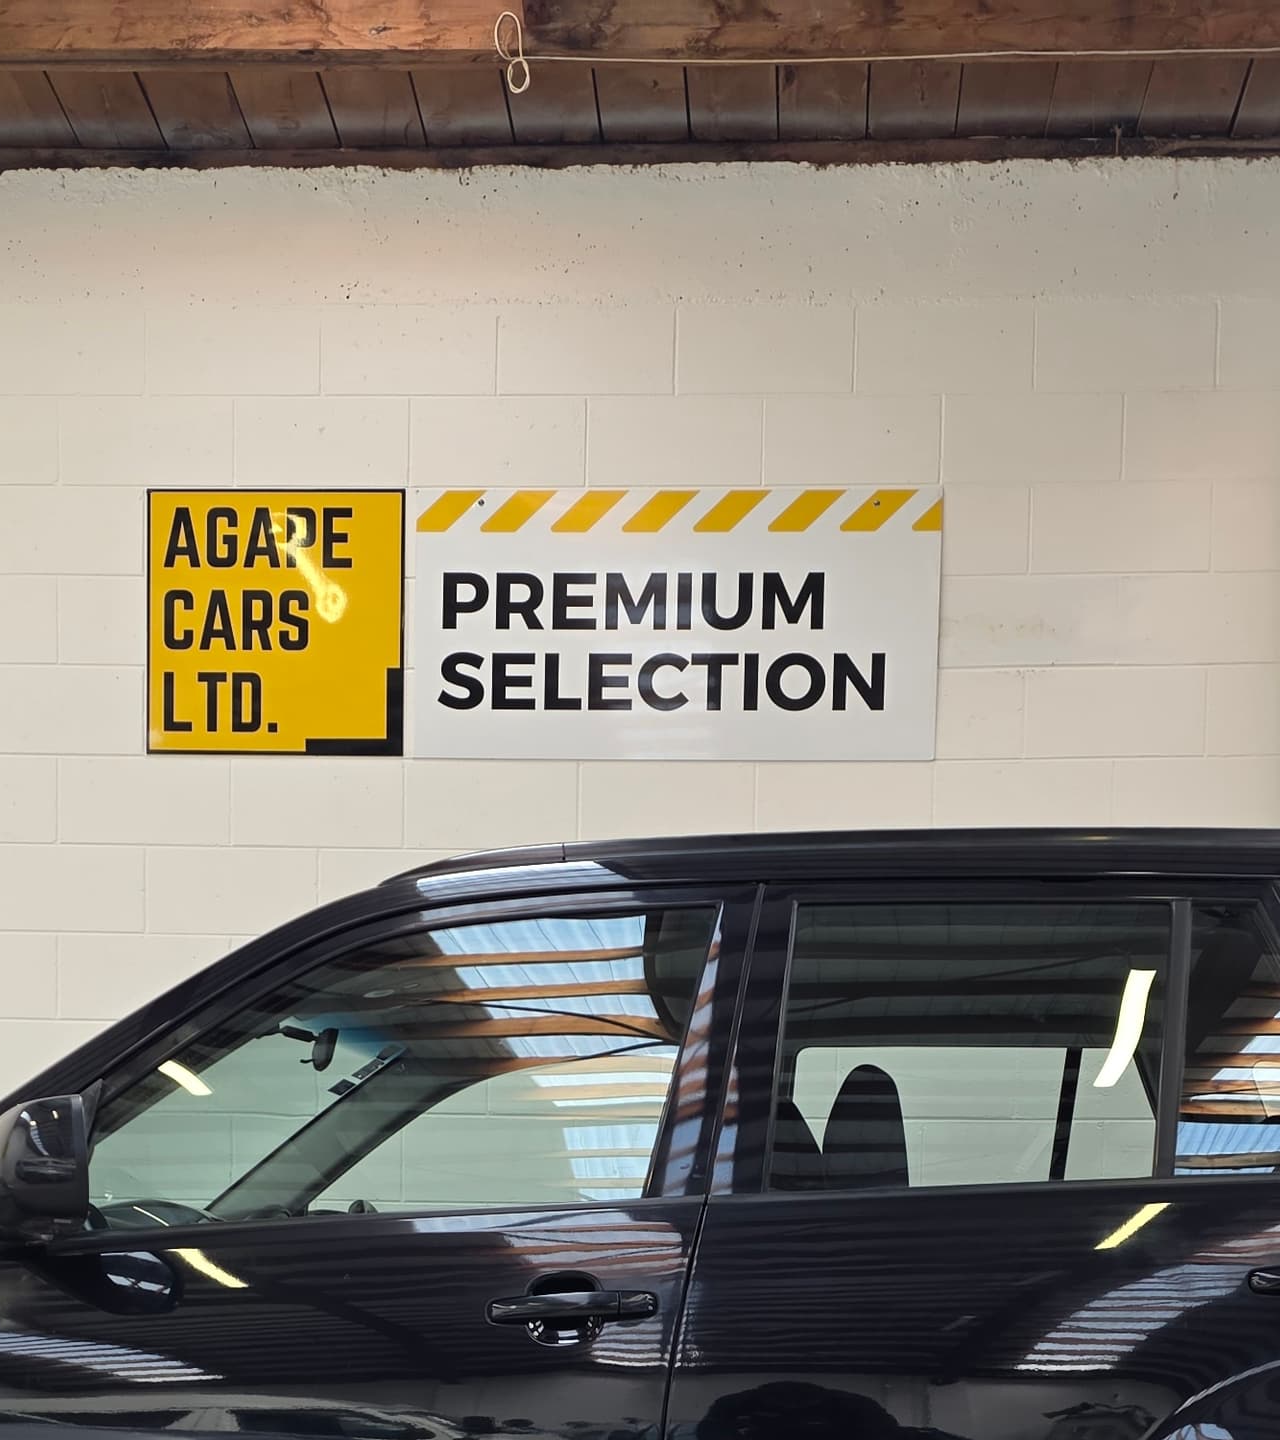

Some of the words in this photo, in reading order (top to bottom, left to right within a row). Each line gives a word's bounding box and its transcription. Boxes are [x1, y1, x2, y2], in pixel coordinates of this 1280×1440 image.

[163, 507, 353, 569] AGAPE
[163, 589, 309, 651] CARS
[441, 572, 825, 630] PREMIUM
[163, 671, 278, 733] LTD.
[437, 652, 886, 712] SELECTION
